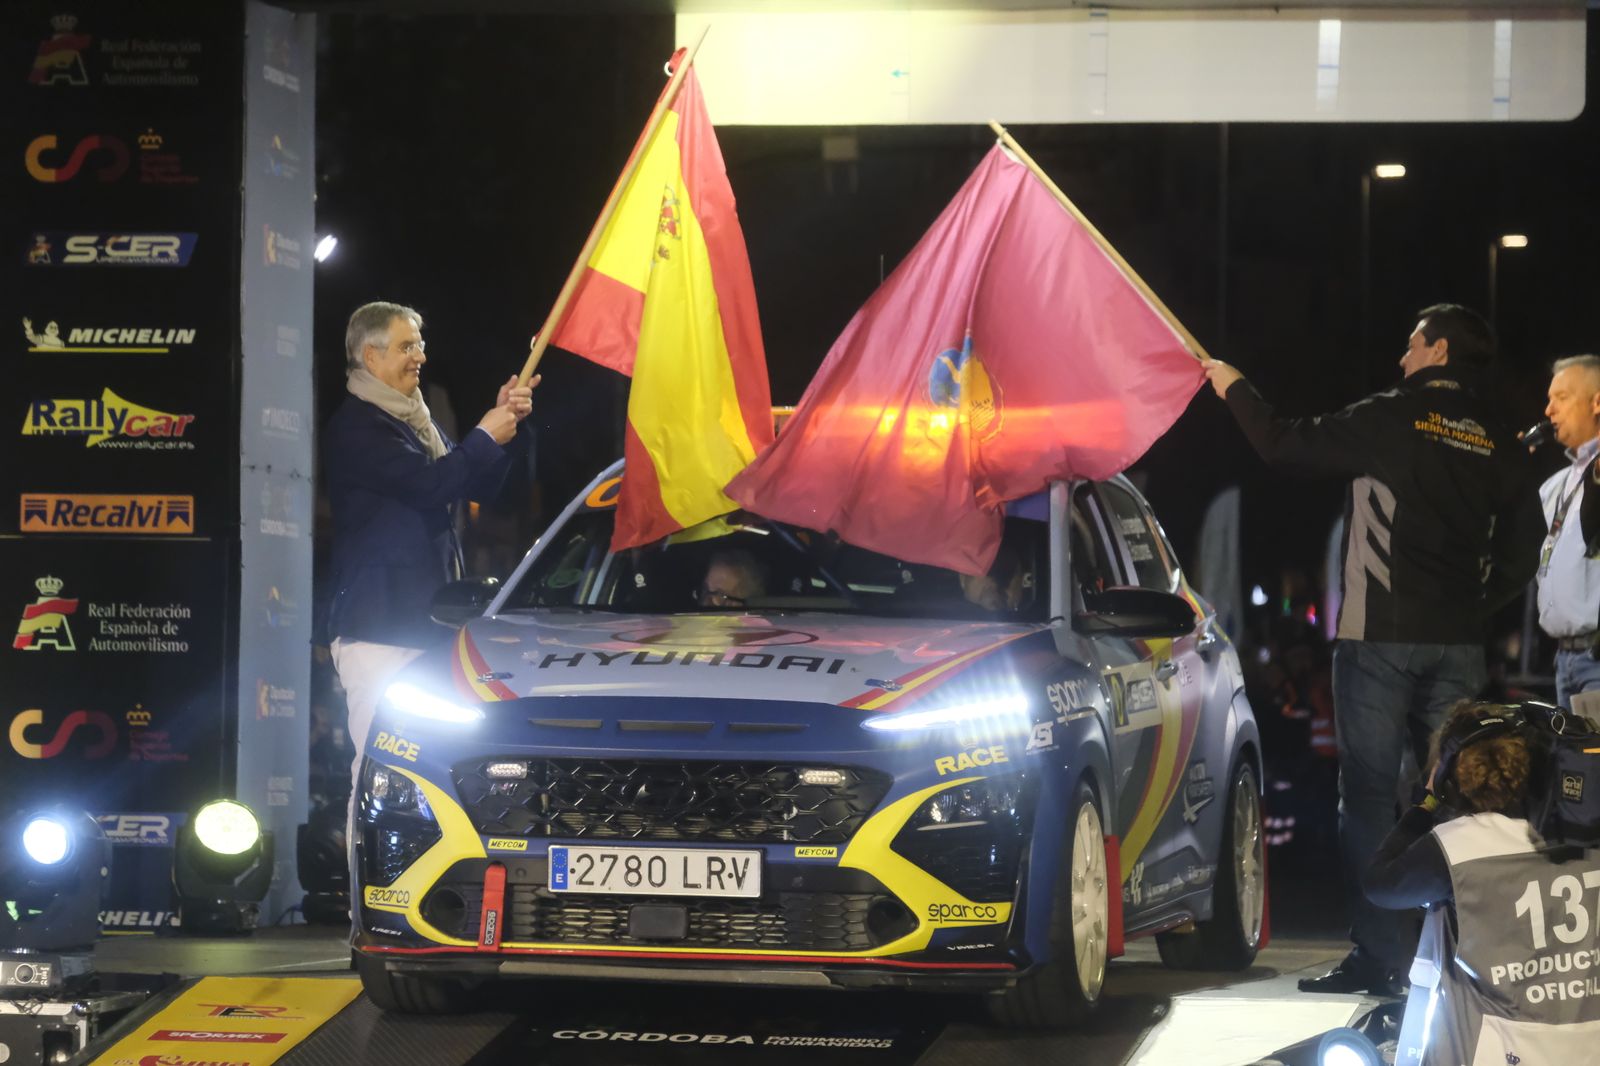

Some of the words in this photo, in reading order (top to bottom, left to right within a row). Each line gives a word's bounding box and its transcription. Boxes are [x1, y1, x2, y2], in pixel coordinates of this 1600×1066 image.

[68, 328, 196, 344] MICHELIN
[1429, 411, 1441, 424] 38
[1414, 420, 1450, 437] SIERRA
[1452, 430, 1495, 449] MORENA
[51, 500, 163, 528] Recalvi
[88, 603, 116, 618] Real
[119, 603, 191, 619] Federación
[100, 621, 158, 637] Española
[162, 620, 179, 635] de
[88, 637, 189, 653] Automovilismo
[538, 650, 846, 676] HYUNDAI
[375, 732, 421, 763] RACE
[934, 745, 1009, 776] RACE
[490, 841, 526, 850] MEYCOM
[797, 849, 836, 857] MEYCOM
[555, 873, 564, 884] E
[575, 853, 668, 888] 2780
[682, 855, 751, 891] LRV
[369, 888, 411, 908] sparco
[928, 903, 998, 924] sparco
